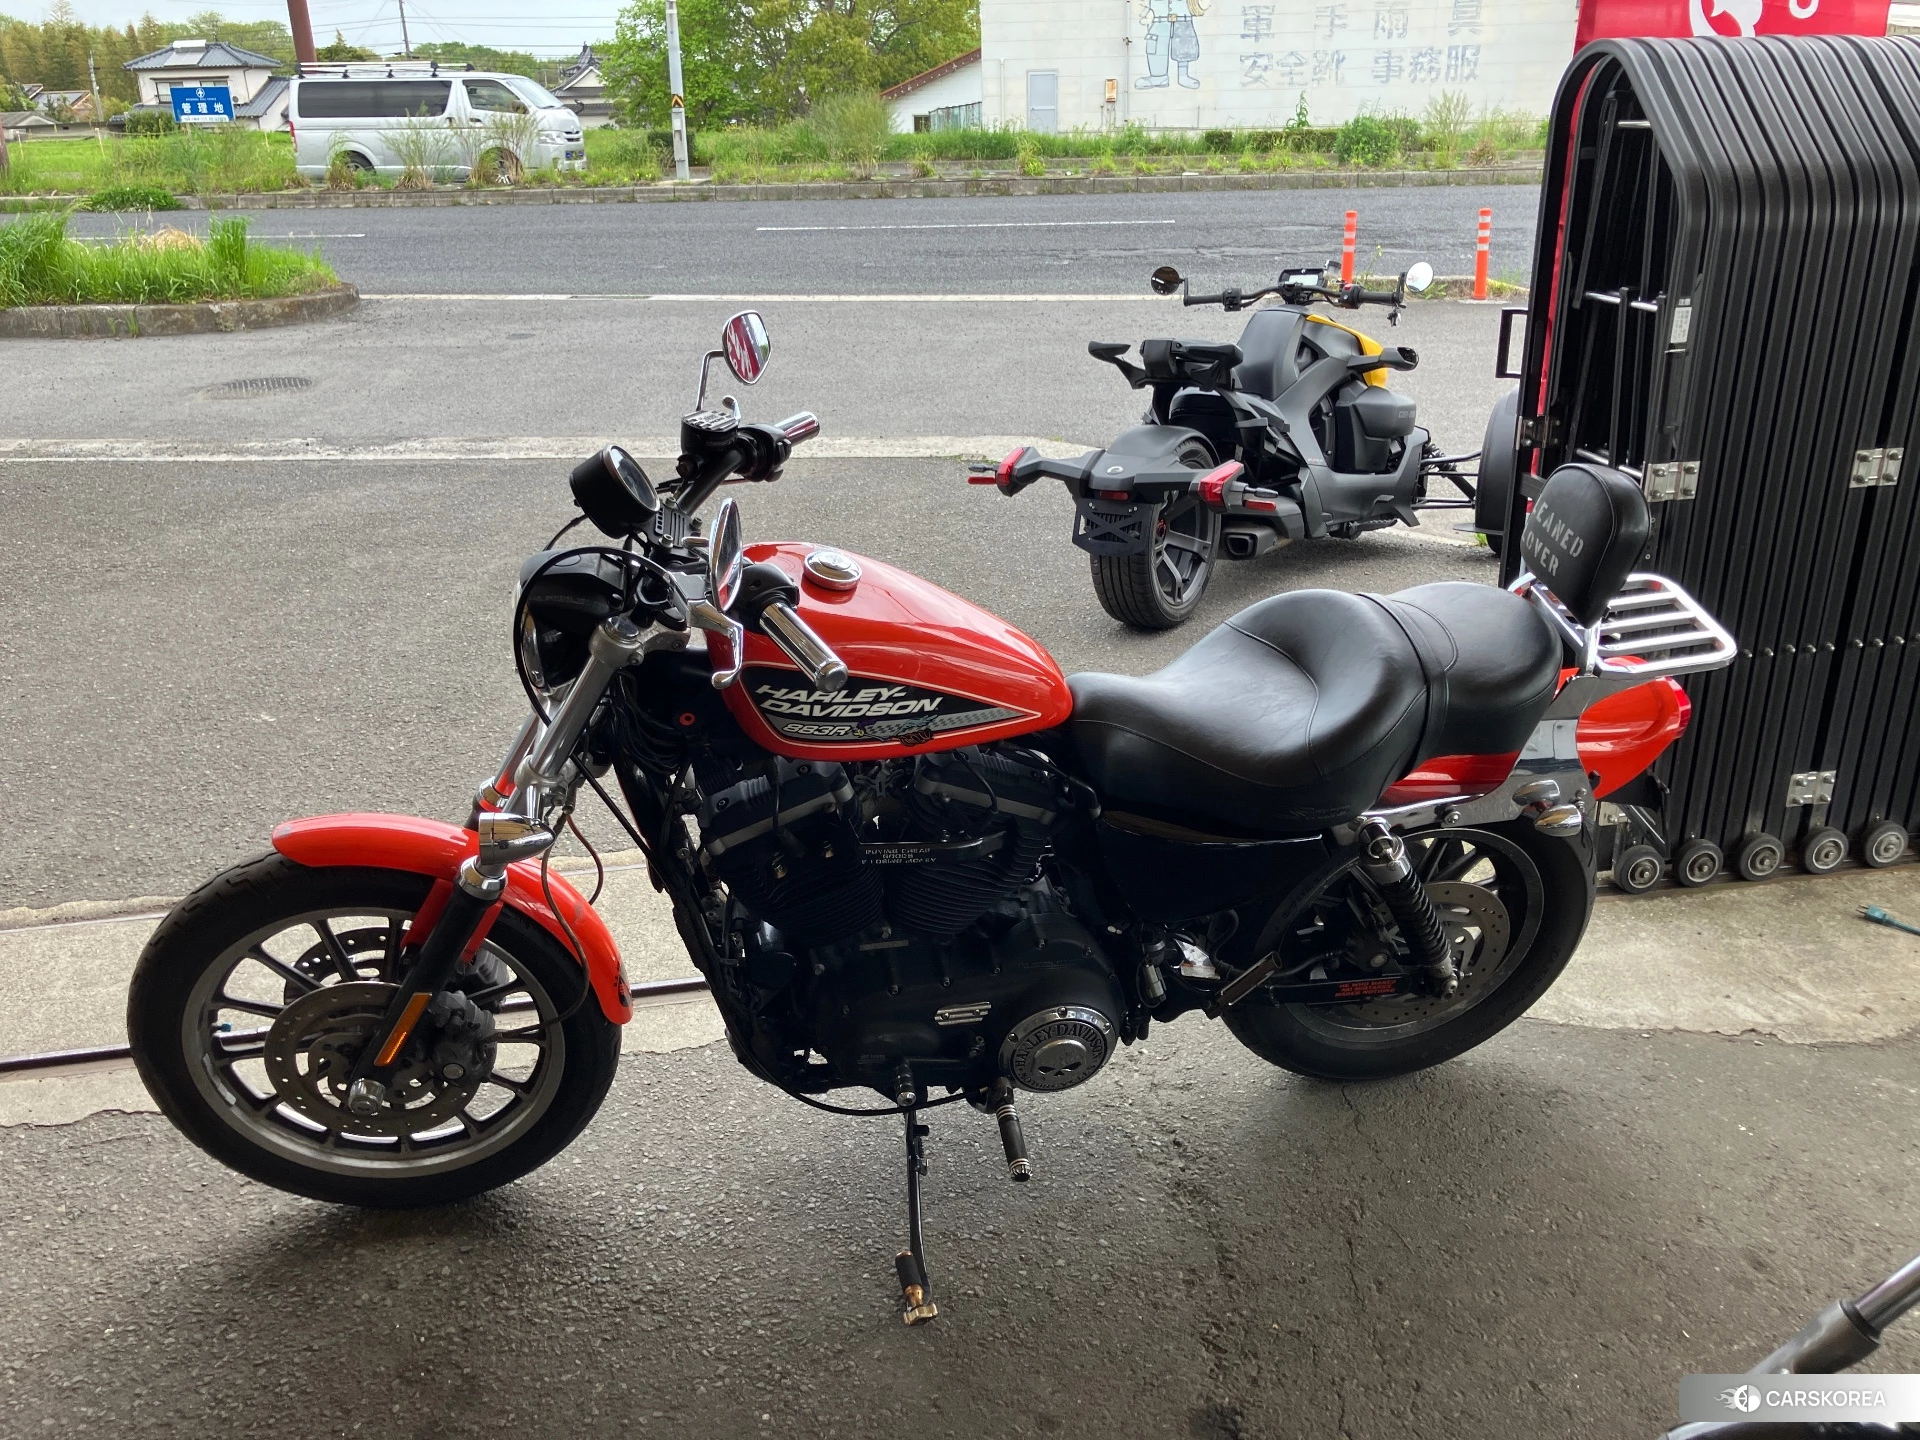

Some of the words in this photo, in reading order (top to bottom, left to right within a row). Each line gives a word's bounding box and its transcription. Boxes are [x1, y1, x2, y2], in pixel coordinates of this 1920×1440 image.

[181, 102, 224, 114] 管理地
[1533, 502, 1584, 557] EANED
[760, 696, 943, 717] DAVIDSON
[783, 722, 851, 737] 883R
